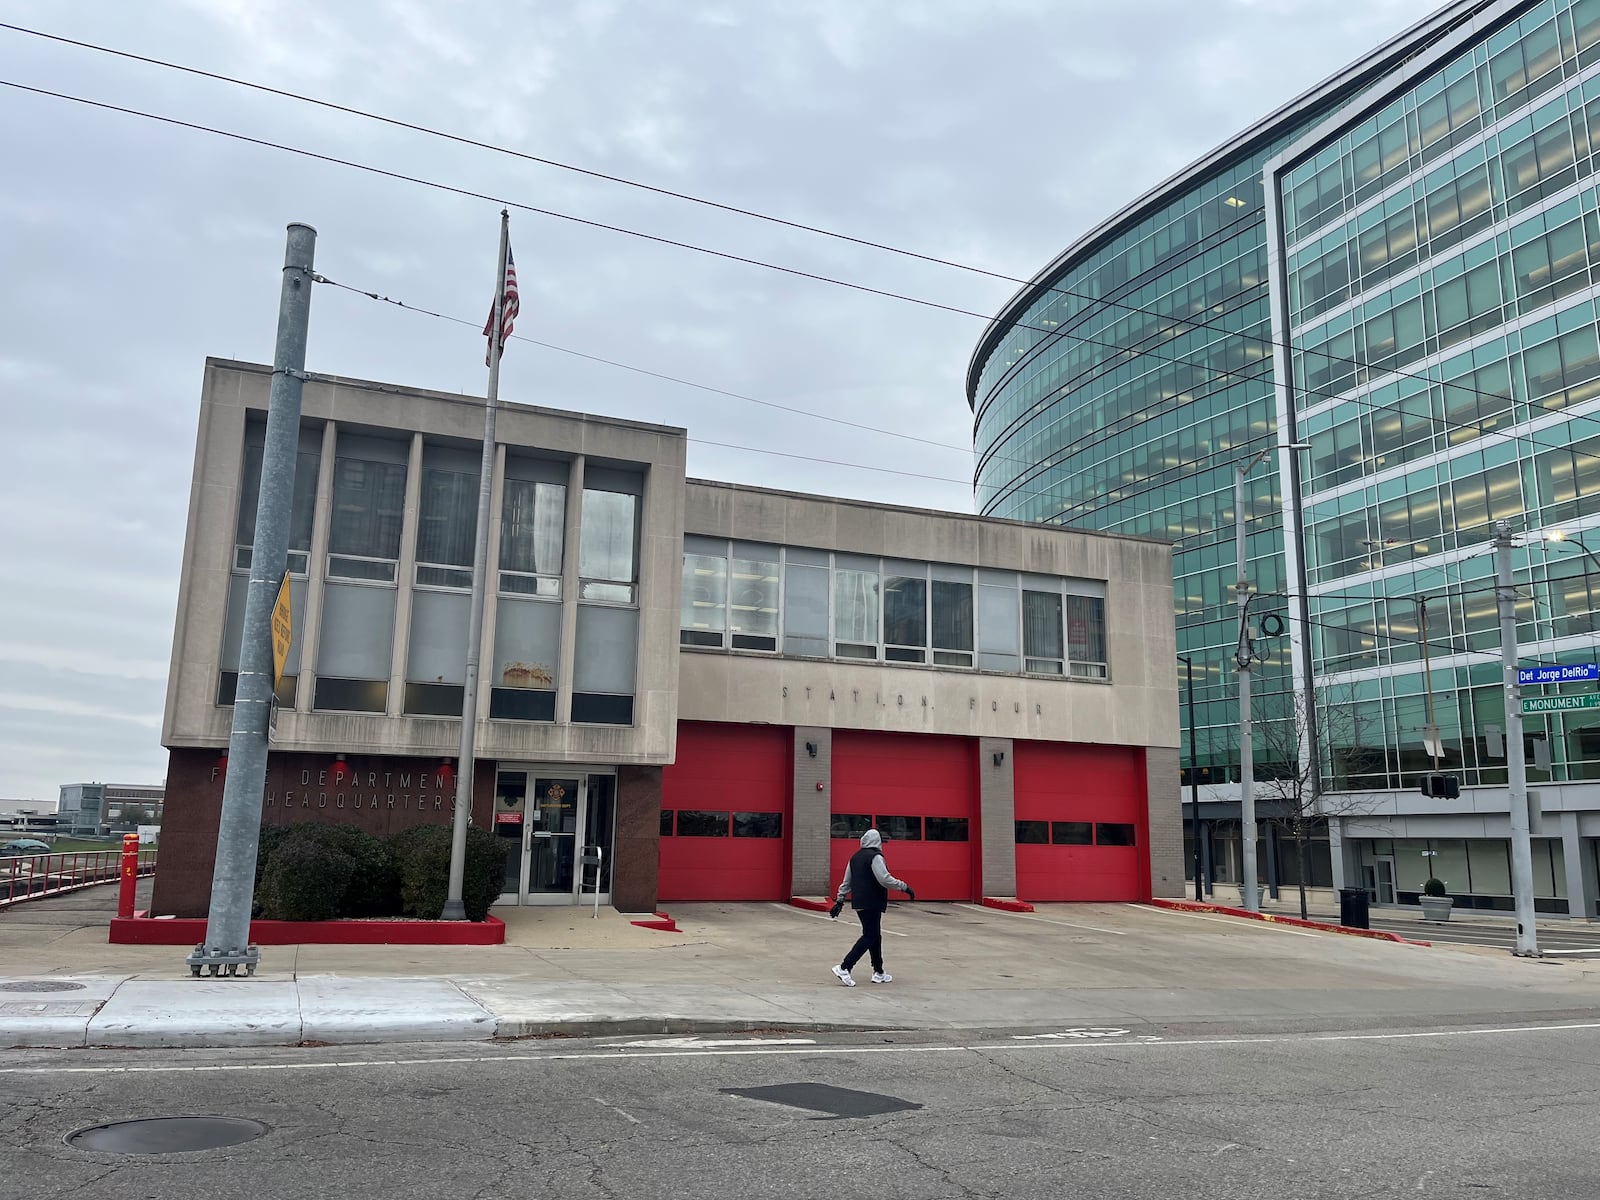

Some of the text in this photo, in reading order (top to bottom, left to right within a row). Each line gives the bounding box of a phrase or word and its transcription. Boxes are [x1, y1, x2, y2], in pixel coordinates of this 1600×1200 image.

[1520, 671, 1533, 681] Det
[1537, 670, 1560, 682] Jorge
[1562, 667, 1589, 678] DelRio
[782, 687, 1041, 715] STATION FOUR
[1524, 702, 1529, 710] E
[1530, 697, 1585, 710] MONUMENT
[211, 767, 458, 789] FE DEPARTMENT
[266, 791, 457, 811] HEADQUARTERS
